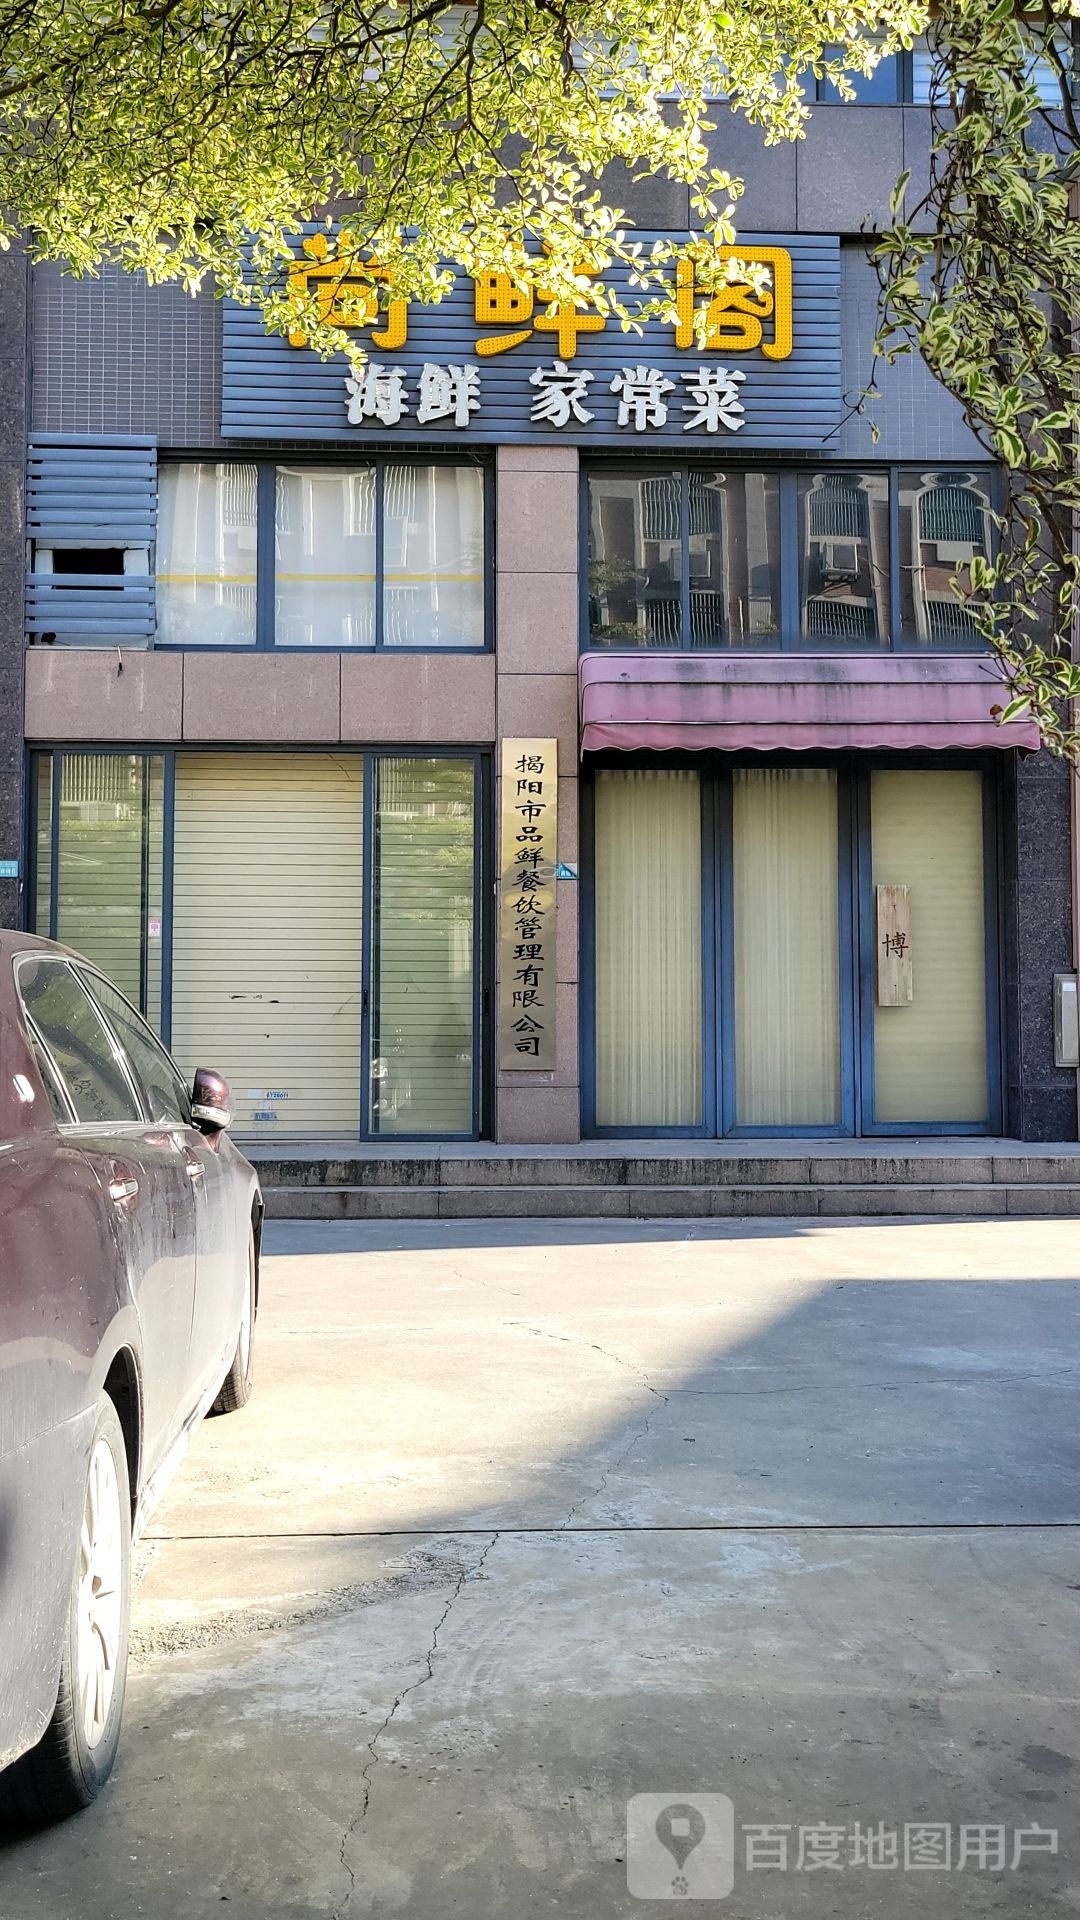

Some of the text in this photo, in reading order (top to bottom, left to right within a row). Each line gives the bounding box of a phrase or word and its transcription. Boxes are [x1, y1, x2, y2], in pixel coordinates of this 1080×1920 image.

[345, 361, 746, 432] 海鲜 家常菜
[511, 754, 546, 1057] 揭阳市品鲜餐饮管理有限公司
[881, 931, 909, 958] 博
